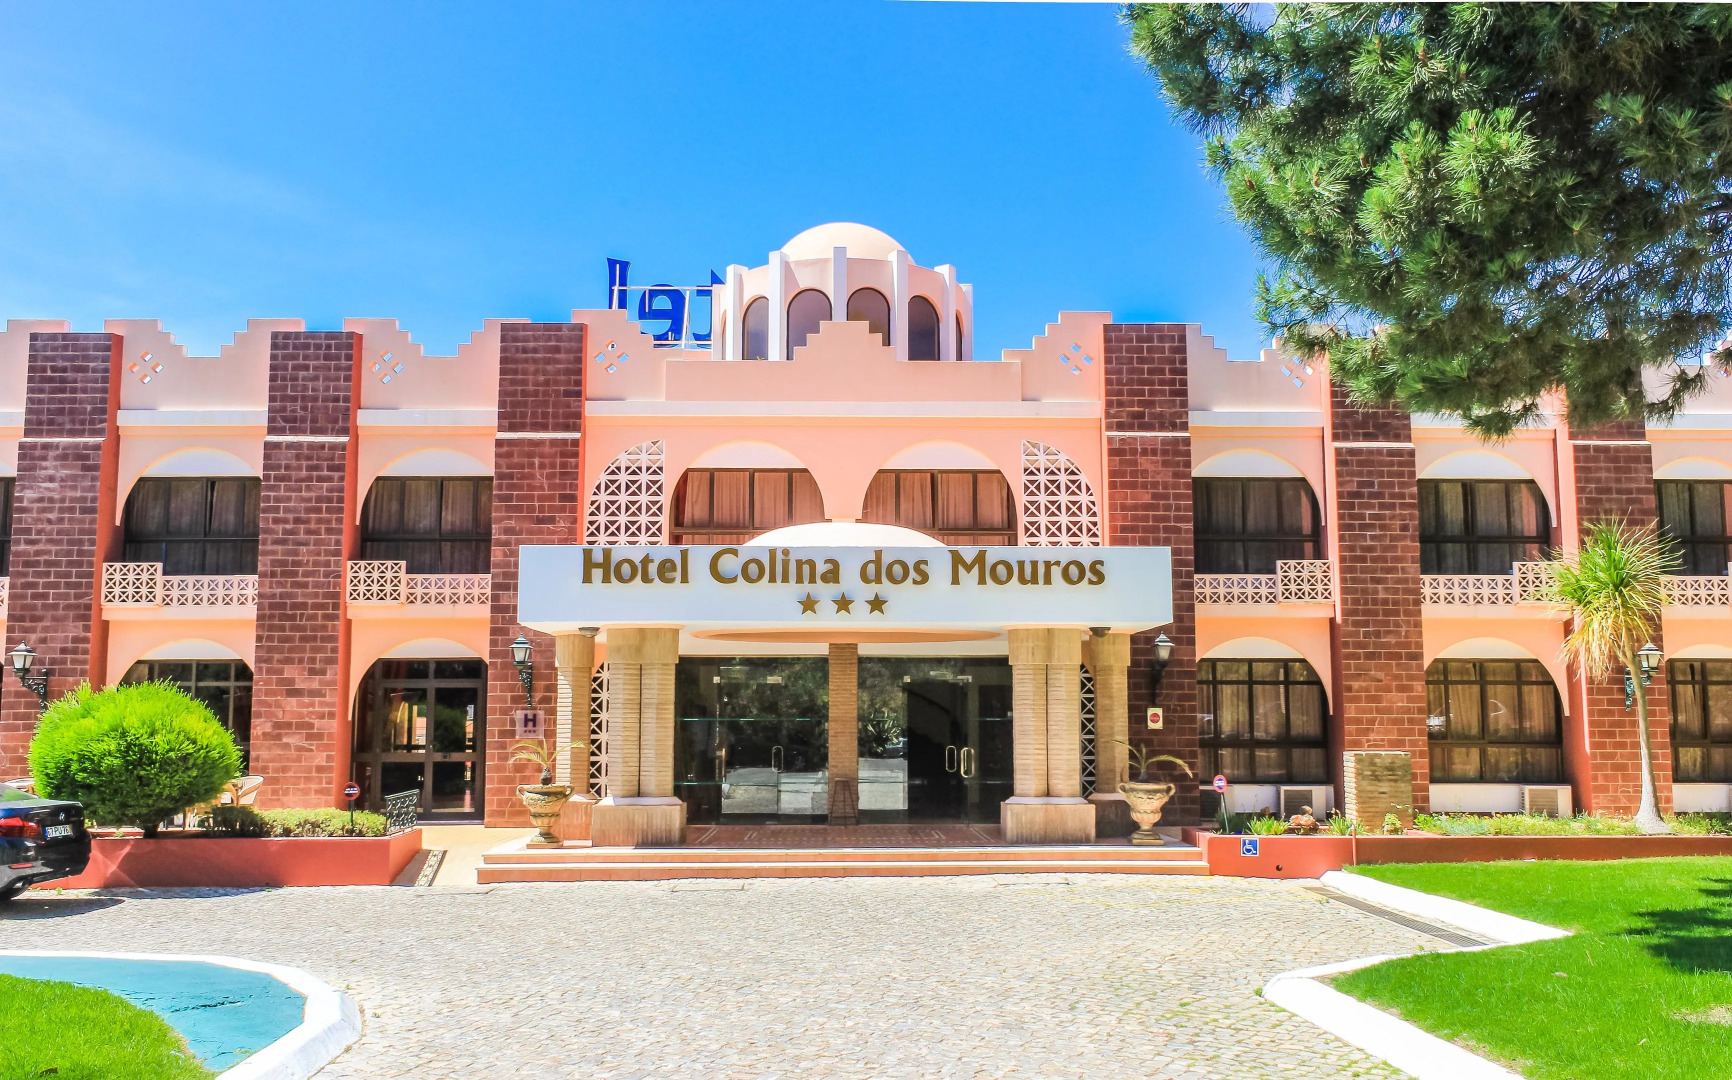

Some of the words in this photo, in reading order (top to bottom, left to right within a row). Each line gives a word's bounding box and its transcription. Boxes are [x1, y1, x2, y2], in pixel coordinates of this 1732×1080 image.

[581, 547, 690, 584] Hotel
[709, 547, 841, 584] Colina
[859, 549, 930, 585] dos
[948, 549, 1106, 586] Mouros
[523, 713, 537, 728] H
